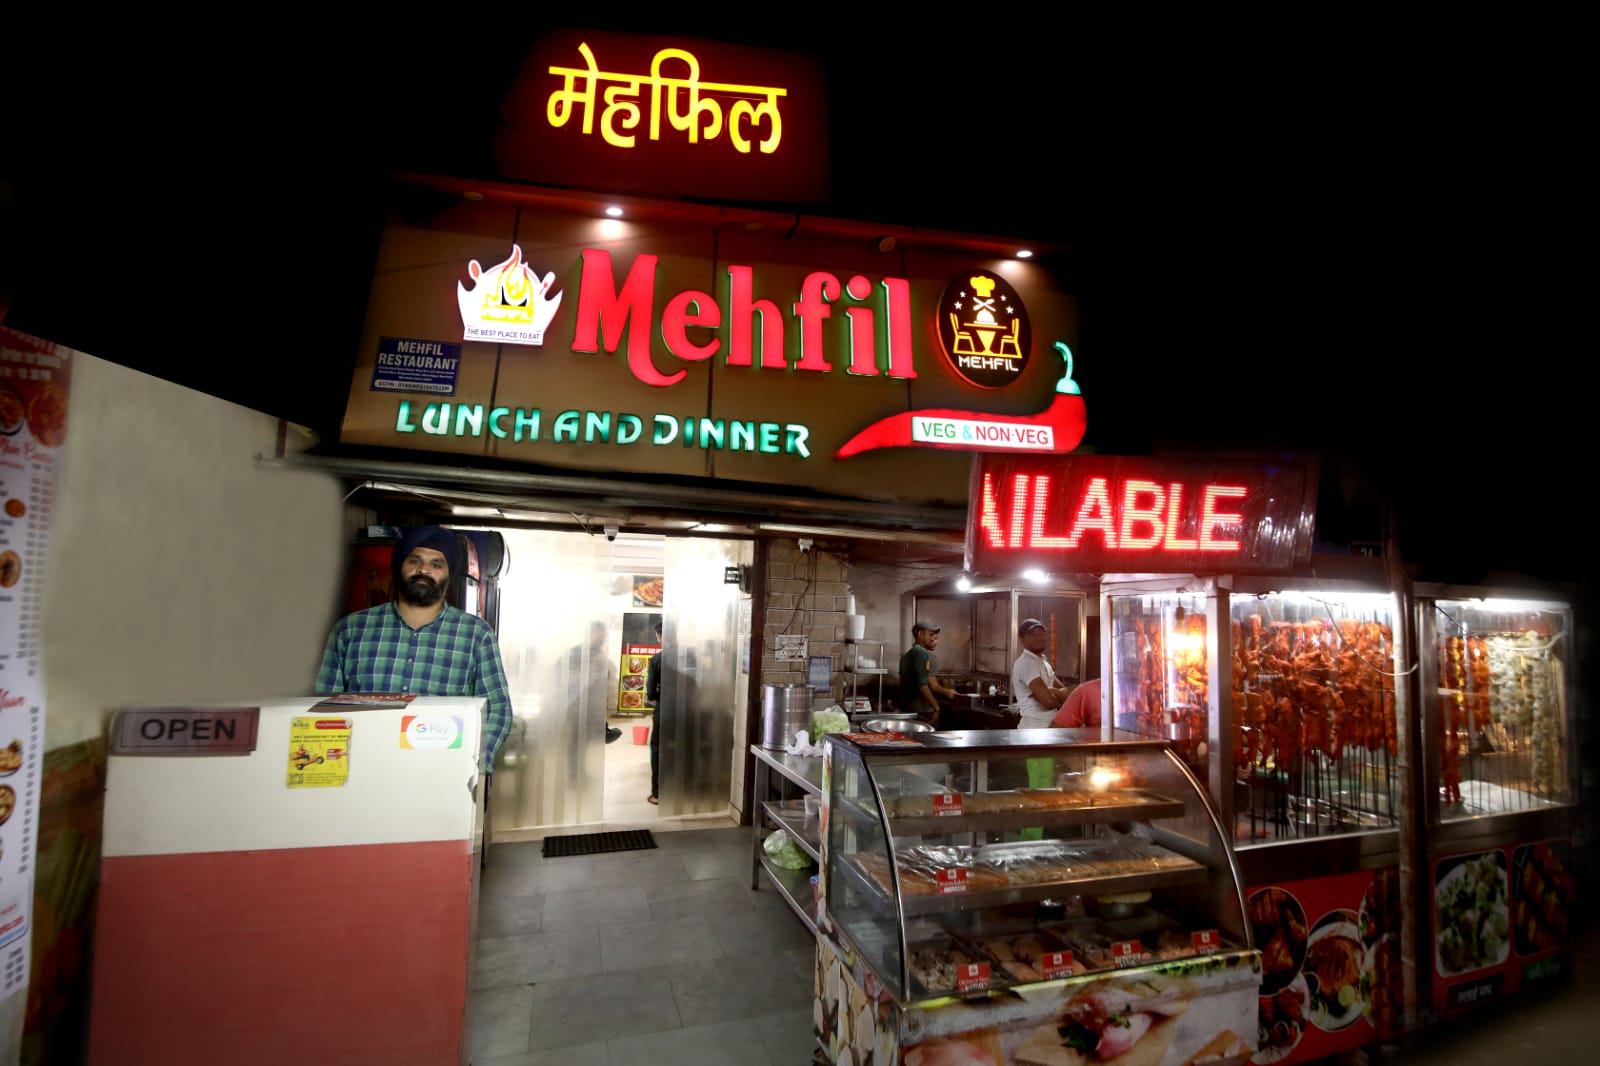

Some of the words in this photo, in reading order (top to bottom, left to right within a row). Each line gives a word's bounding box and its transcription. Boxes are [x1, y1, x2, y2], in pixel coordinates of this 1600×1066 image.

[547, 42, 787, 154] मेहफिल
[571, 247, 918, 387] Mehfil
[467, 328, 479, 336] THE
[481, 329, 496, 337] BEST
[497, 330, 518, 339] PLACE
[397, 341, 444, 356] MEHFIL
[378, 353, 458, 370] RESTAURANT
[958, 355, 1019, 373] MEHFIL
[395, 400, 541, 443] LUNCH
[553, 410, 643, 445] AND
[653, 413, 811, 458] DINNER
[921, 421, 956, 439] VEG
[962, 424, 973, 440] &
[976, 425, 1049, 446] NON-VEG
[140, 718, 237, 742] OPEN
